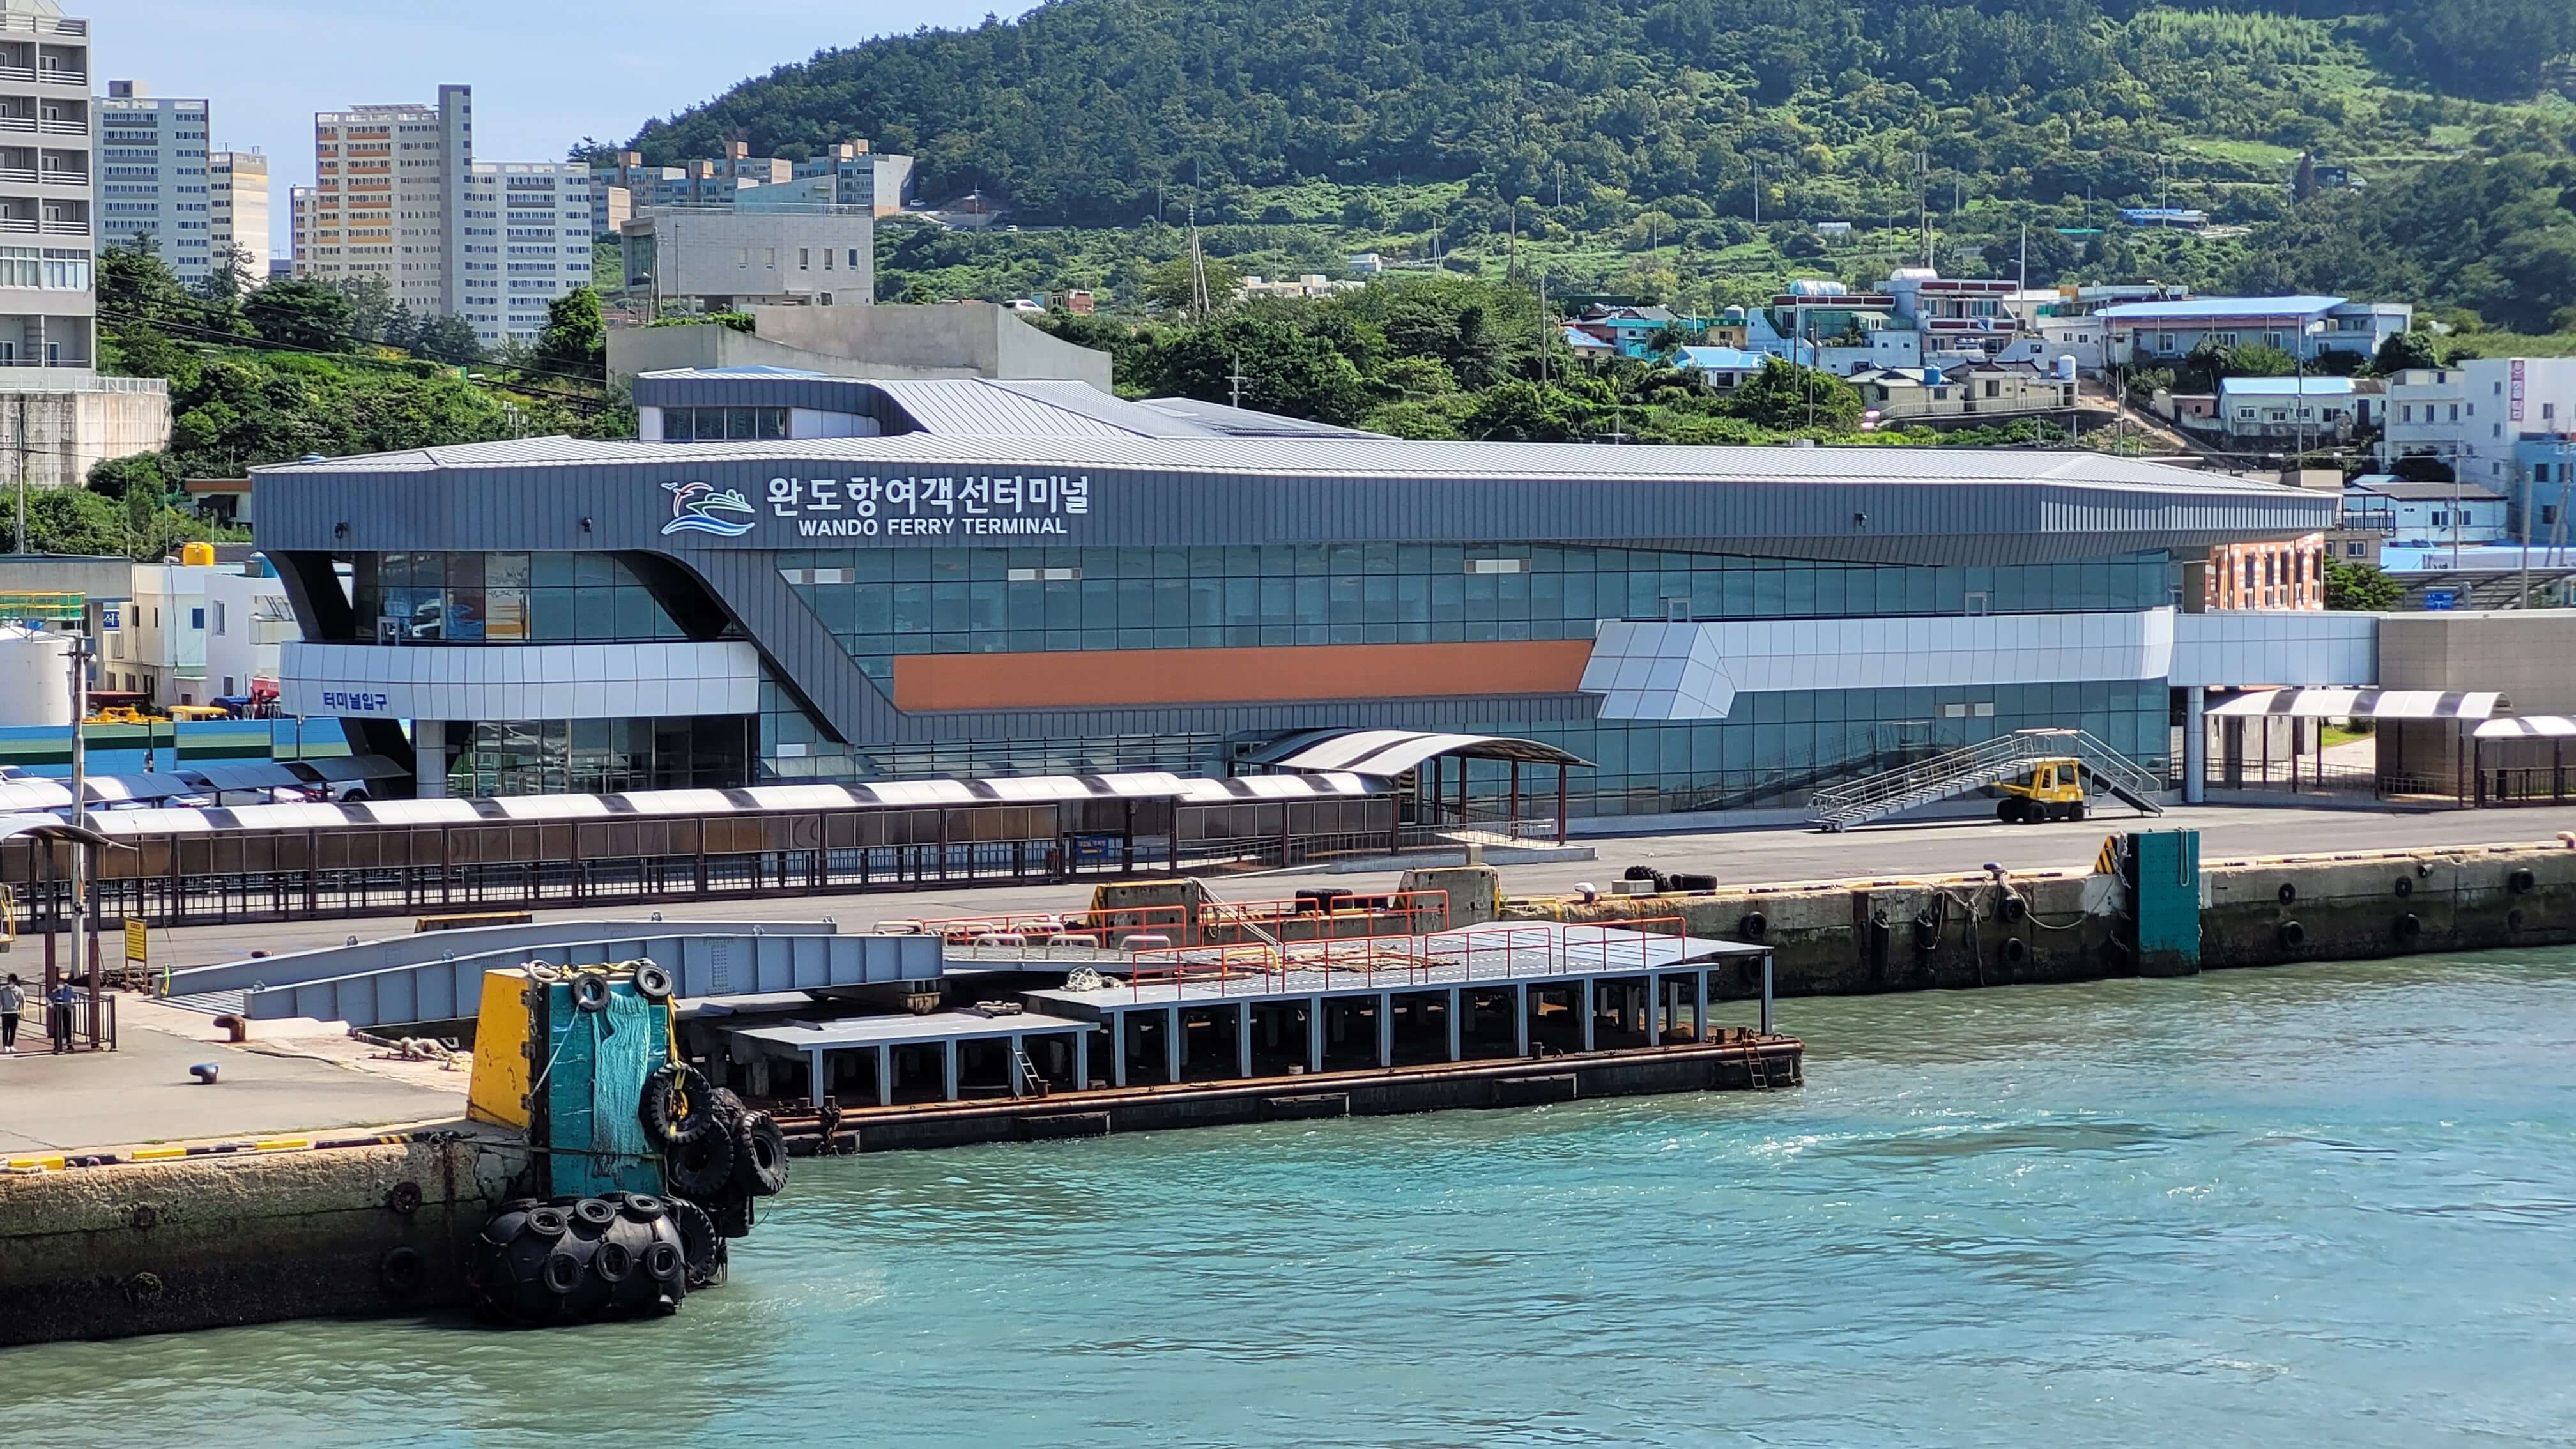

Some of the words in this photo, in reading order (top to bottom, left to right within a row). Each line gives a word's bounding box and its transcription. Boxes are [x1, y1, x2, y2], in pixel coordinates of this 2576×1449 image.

[767, 475, 1088, 517] 완도항여객선터미널
[798, 519, 878, 536] WANDO
[887, 518, 955, 535] FERRY
[961, 518, 1068, 535] TERMINAL
[323, 692, 387, 711] 터미널입구
